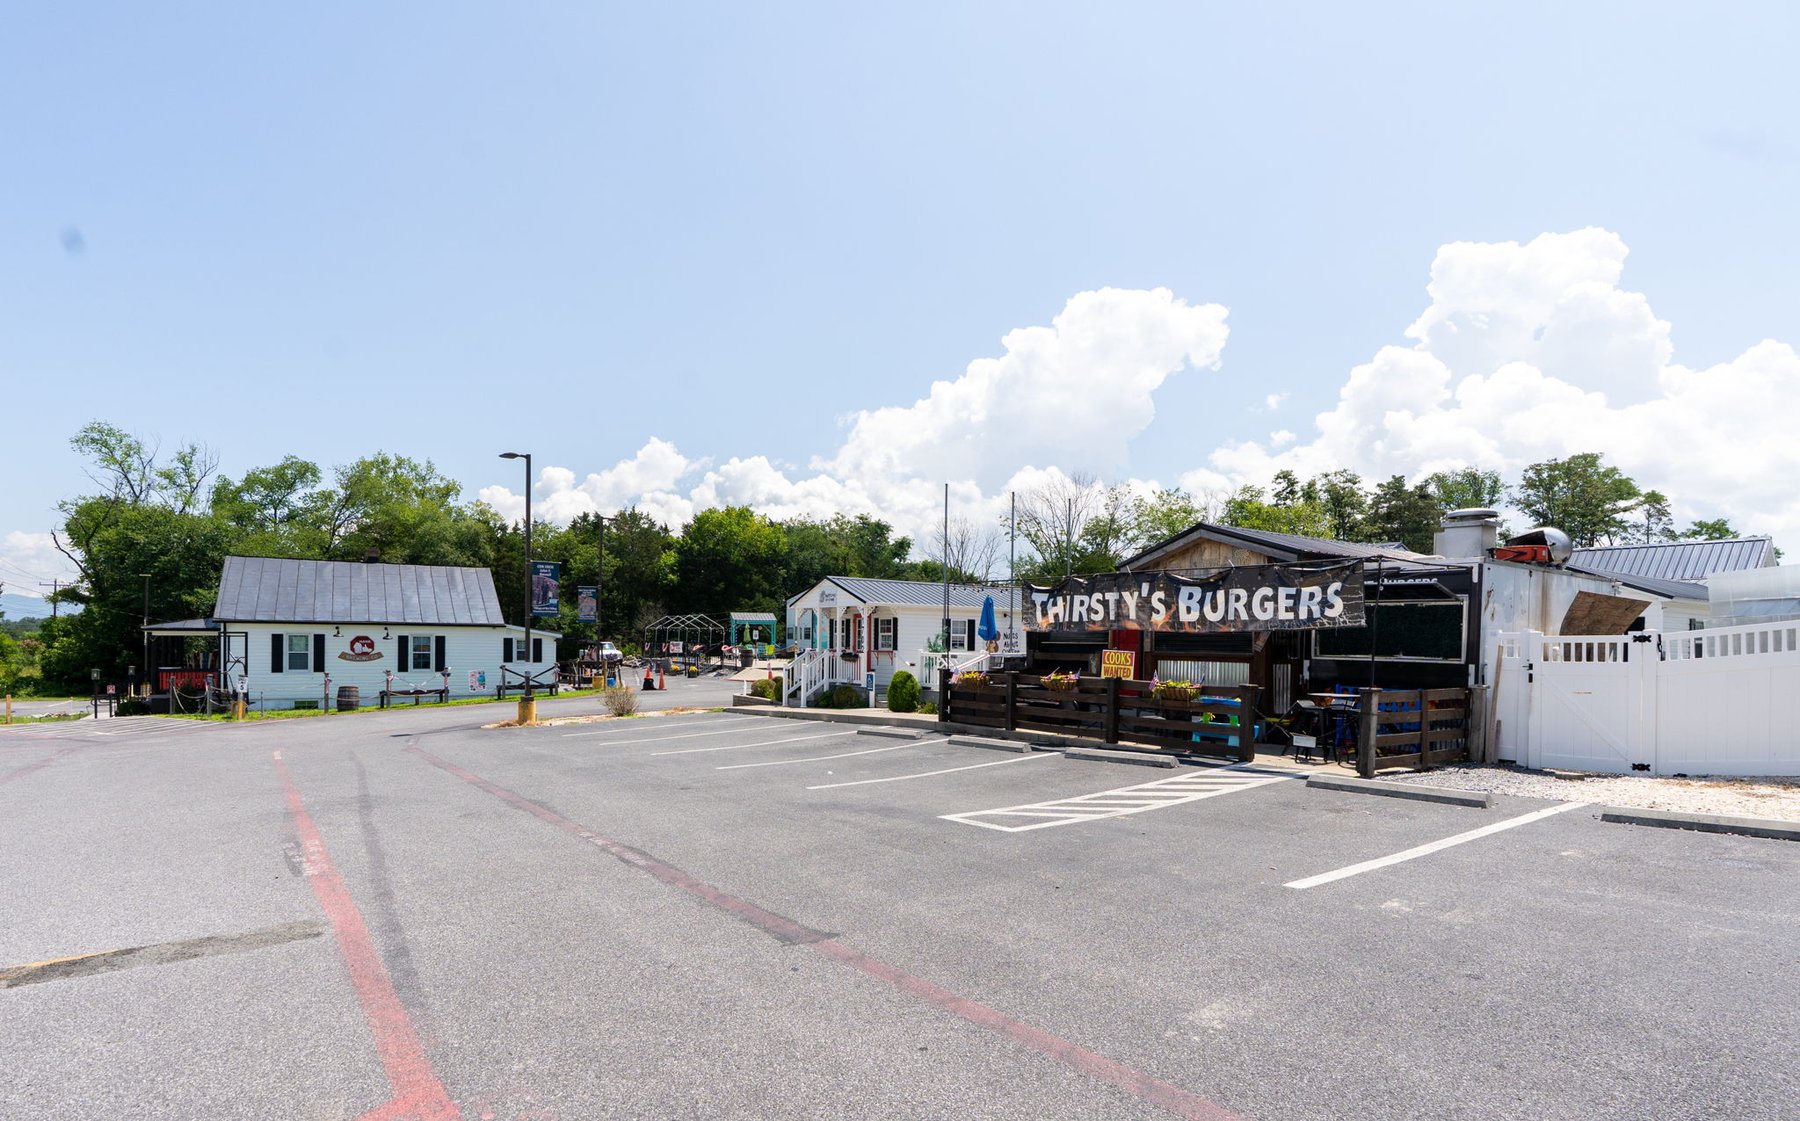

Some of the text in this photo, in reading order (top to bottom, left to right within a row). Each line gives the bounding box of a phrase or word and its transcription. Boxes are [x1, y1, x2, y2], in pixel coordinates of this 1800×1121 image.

[1031, 581, 1344, 624] THIRSTY'S BURGERS
[1104, 652, 1132, 666] COOKS
[1103, 666, 1132, 678] WANTED
